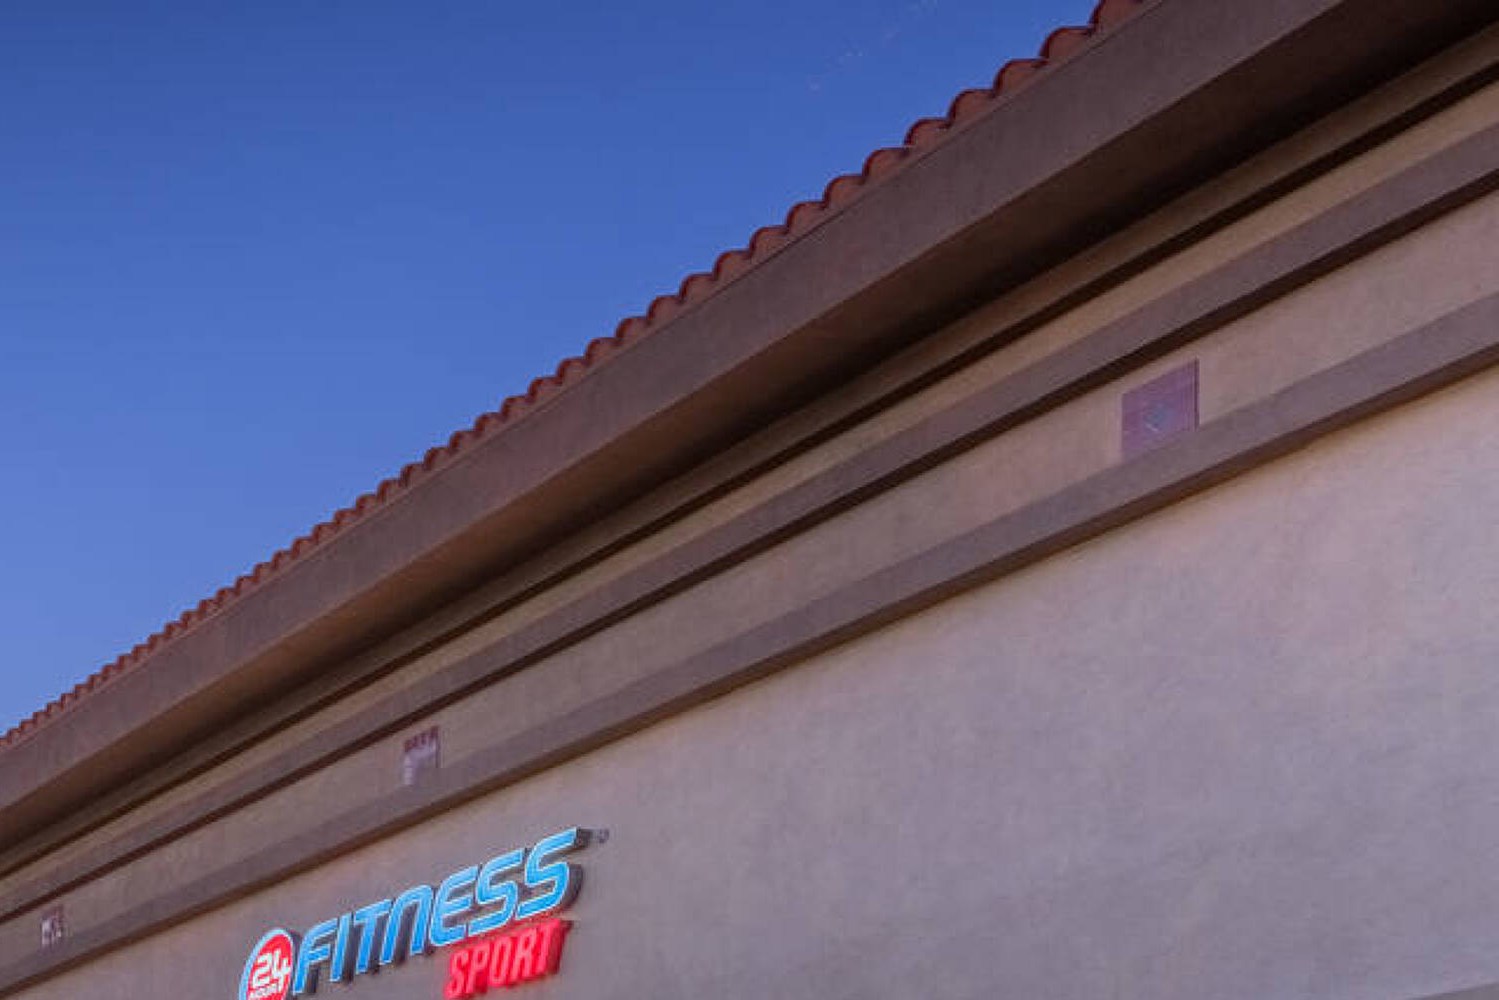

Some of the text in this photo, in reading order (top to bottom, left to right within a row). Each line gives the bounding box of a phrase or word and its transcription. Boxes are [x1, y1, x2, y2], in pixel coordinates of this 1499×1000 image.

[251, 826, 579, 996] 24 FITNESS
[443, 918, 570, 1000] SPORT
